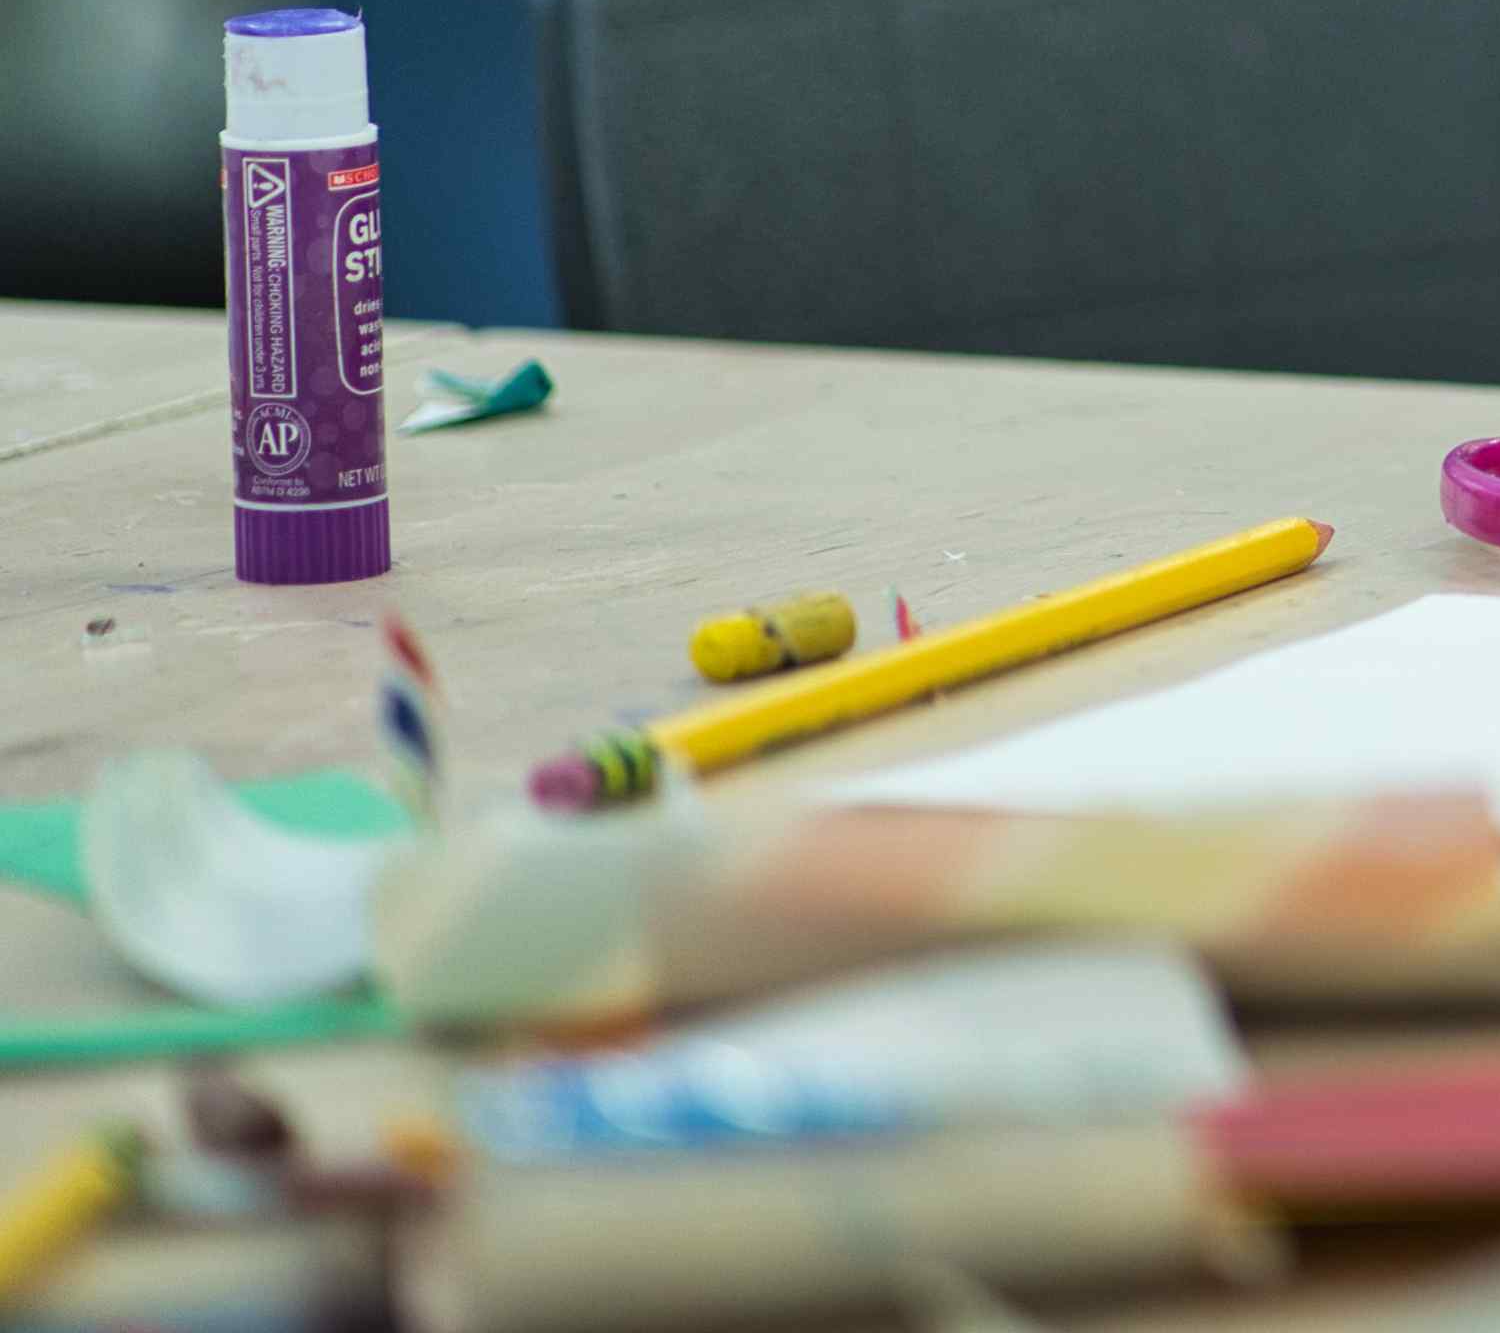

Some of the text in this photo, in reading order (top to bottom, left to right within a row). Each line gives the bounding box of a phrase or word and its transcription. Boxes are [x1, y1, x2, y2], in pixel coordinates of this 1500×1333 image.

[250, 211, 263, 234] Small
[252, 265, 263, 282] Not
[253, 284, 264, 297] for
[266, 205, 287, 392] WARNING: CHOKING HAZARD
[253, 299, 265, 336] children
[255, 337, 265, 364] under
[256, 421, 298, 455] AP
[338, 469, 362, 488] NET
